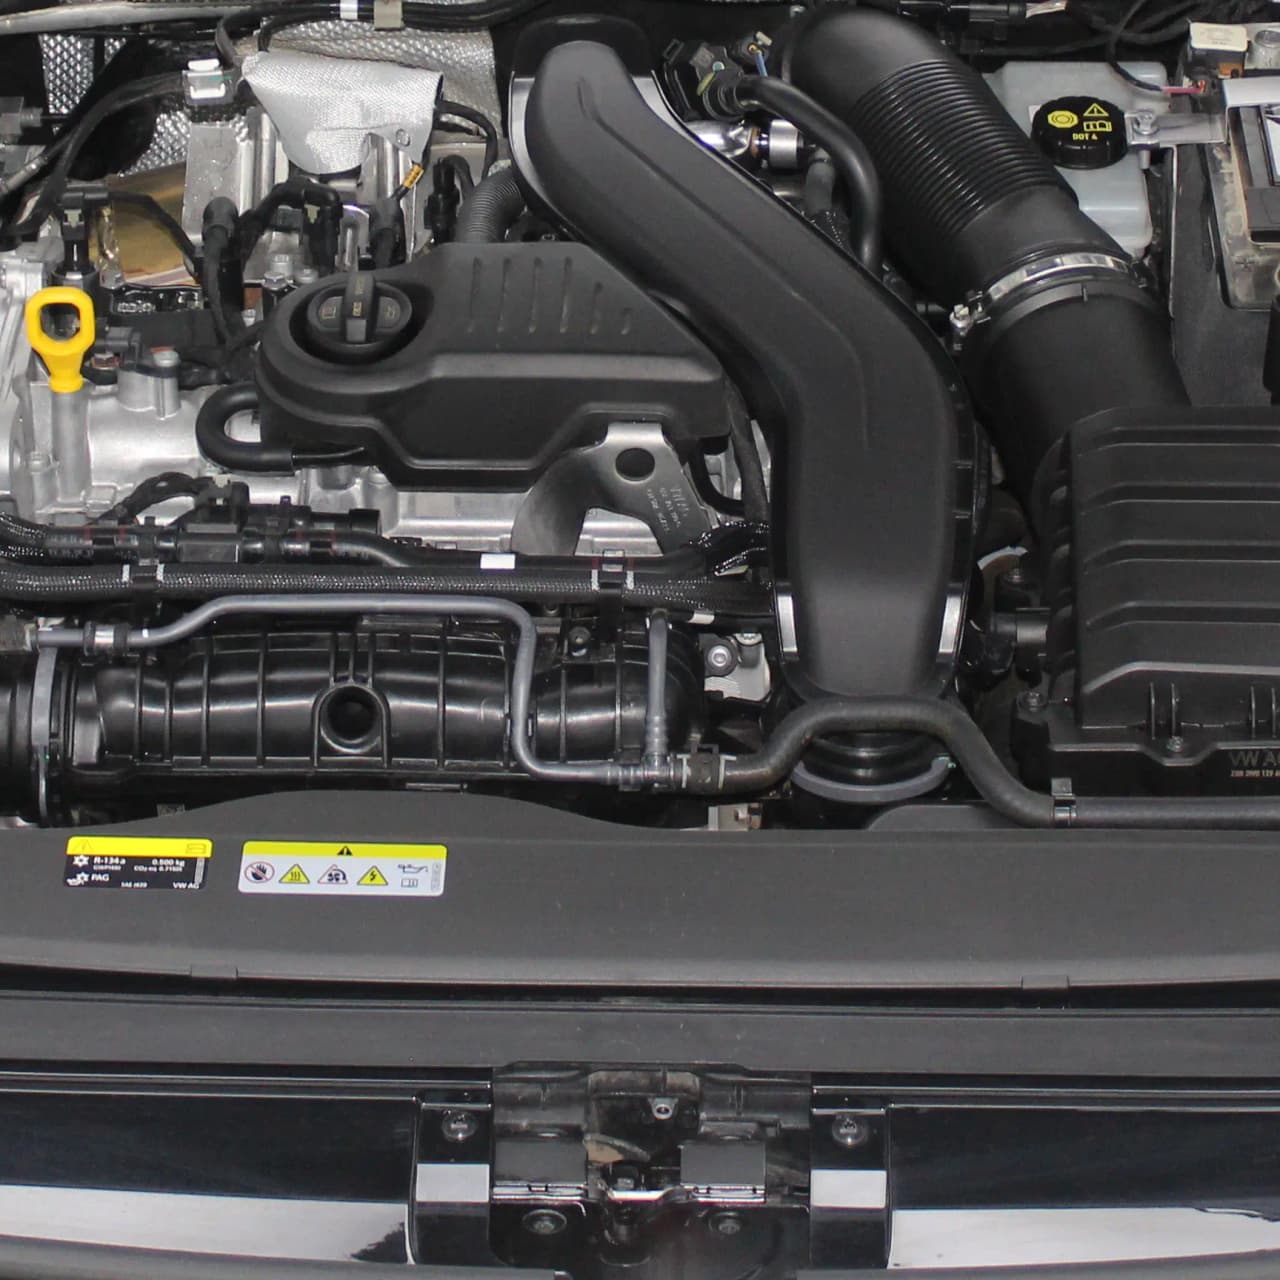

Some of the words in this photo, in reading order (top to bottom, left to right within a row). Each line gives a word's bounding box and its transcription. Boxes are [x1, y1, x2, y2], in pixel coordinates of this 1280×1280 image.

[1073, 133, 1090, 141] DOT
[1091, 133, 1098, 141] 4
[1228, 750, 1260, 767] VW
[175, 859, 185, 868] kg
[173, 882, 188, 890] VW
[188, 882, 200, 890] AG
